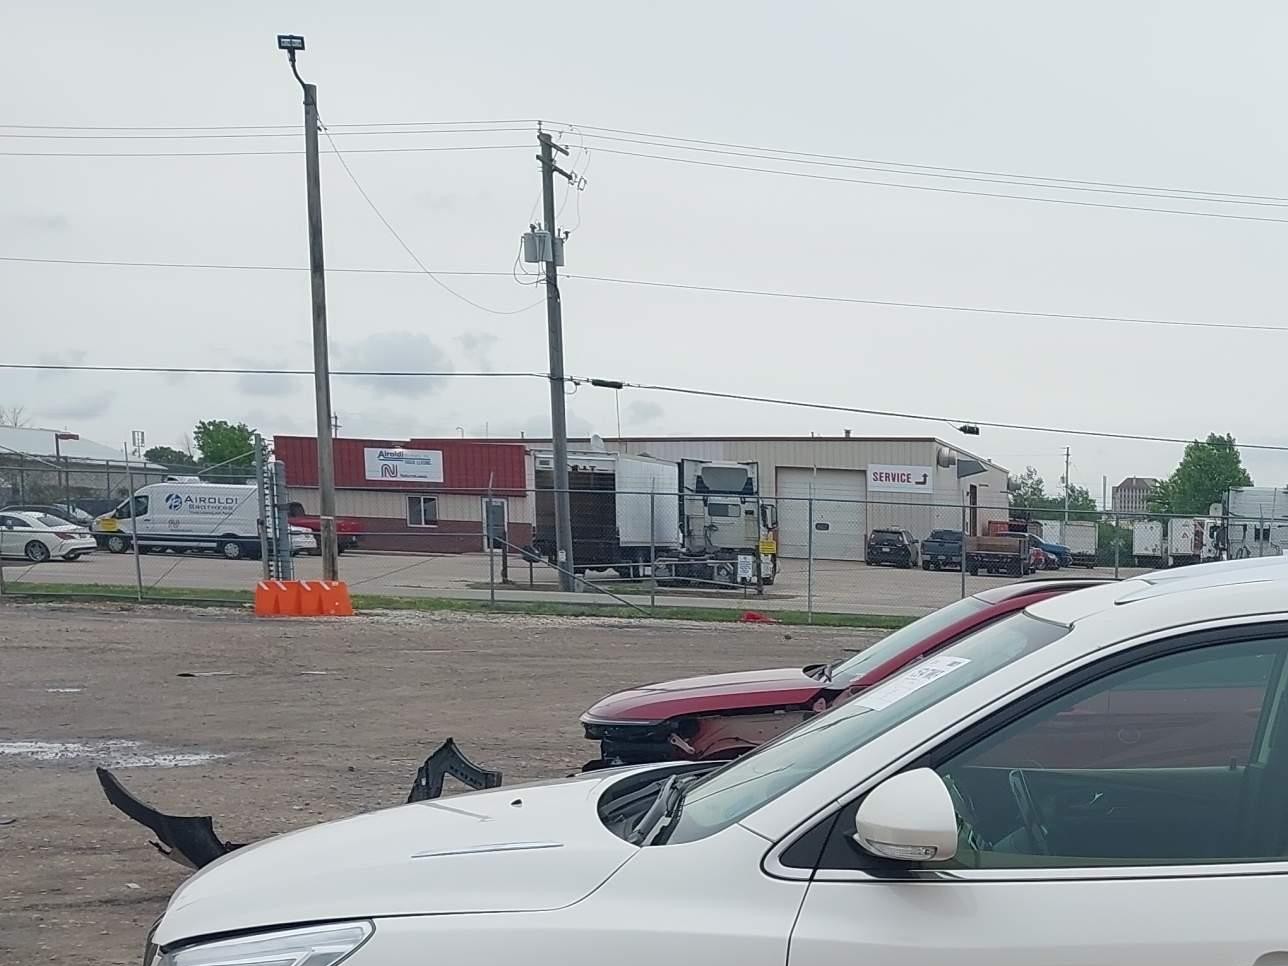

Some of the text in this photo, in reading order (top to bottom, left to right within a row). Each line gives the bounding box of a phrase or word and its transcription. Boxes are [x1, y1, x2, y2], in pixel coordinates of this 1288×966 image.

[377, 450, 404, 458] Airoldi
[872, 471, 912, 483] SERVICE
[184, 495, 238, 505] AIROLDI
